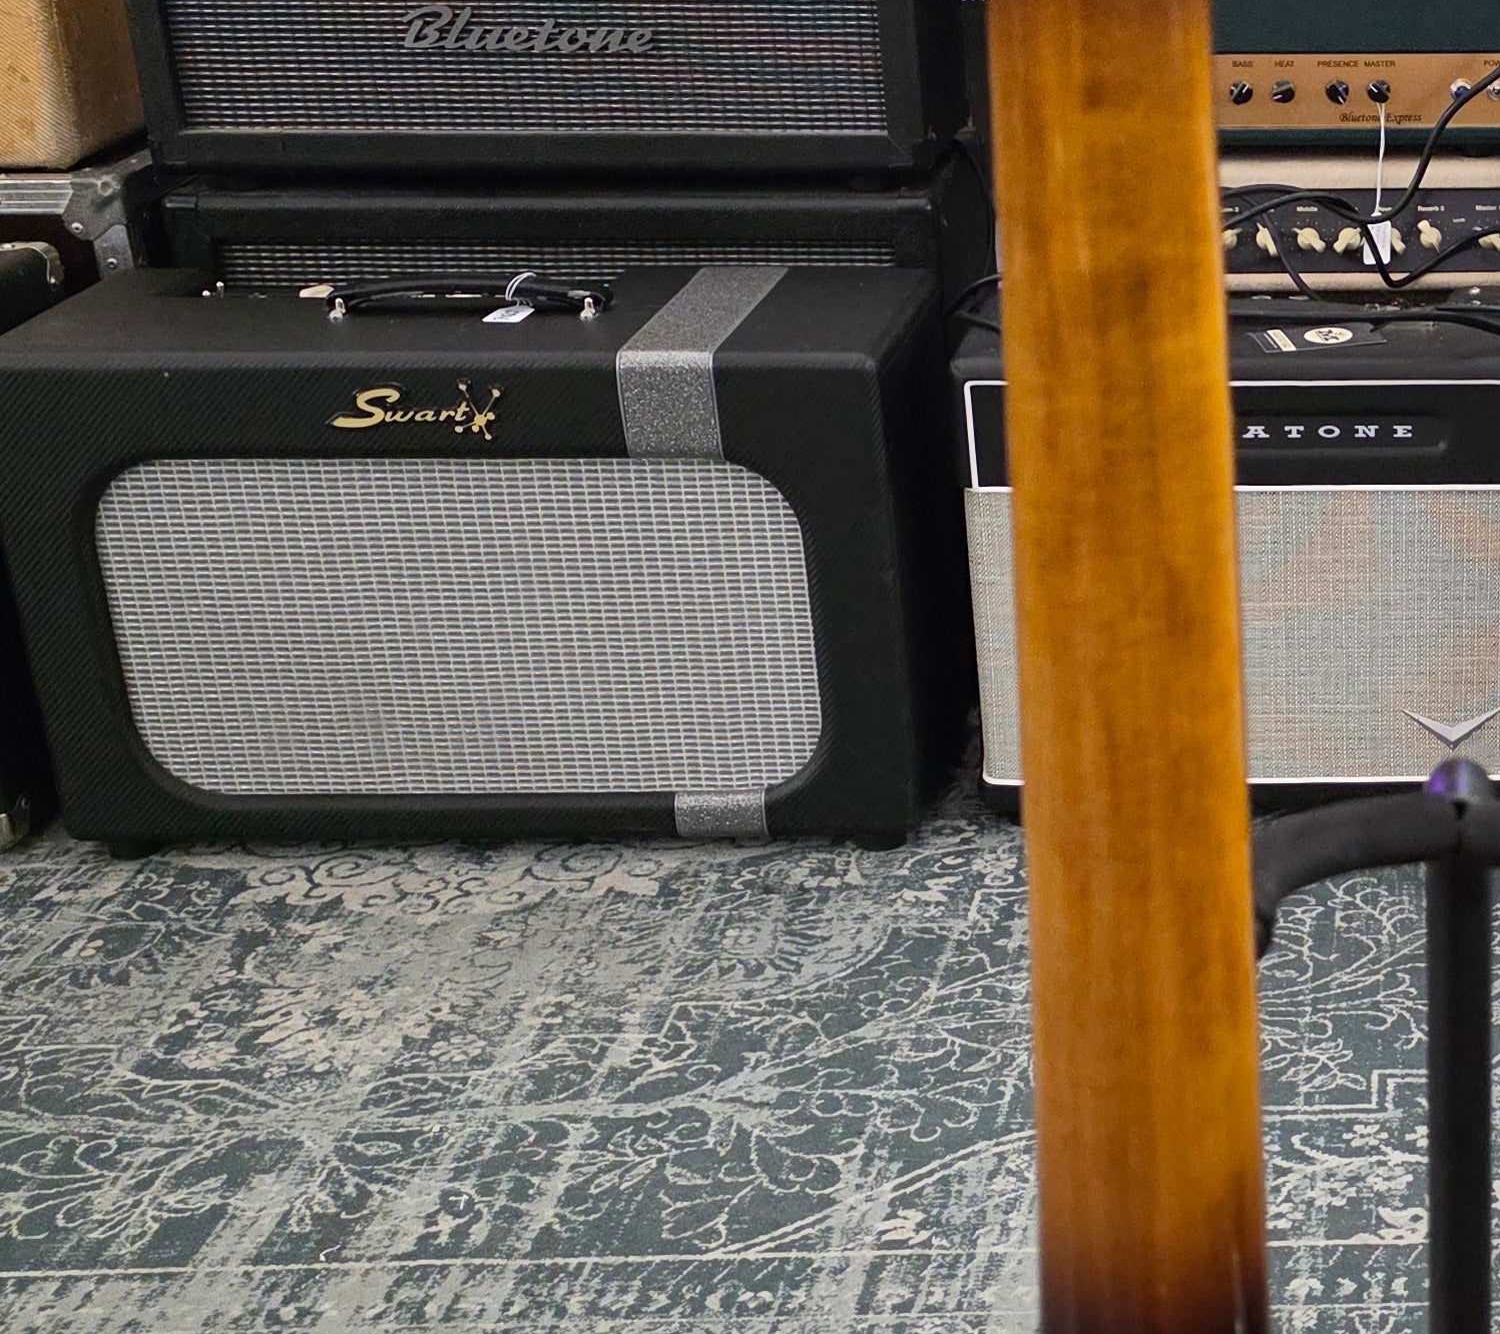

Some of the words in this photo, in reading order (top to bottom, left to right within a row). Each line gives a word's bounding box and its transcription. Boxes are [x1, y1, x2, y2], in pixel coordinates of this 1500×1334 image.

[402, 5, 654, 53] Bluetone
[1385, 112, 1422, 125] Express
[326, 383, 470, 429] Swart
[1242, 425, 1413, 439] ATONE
